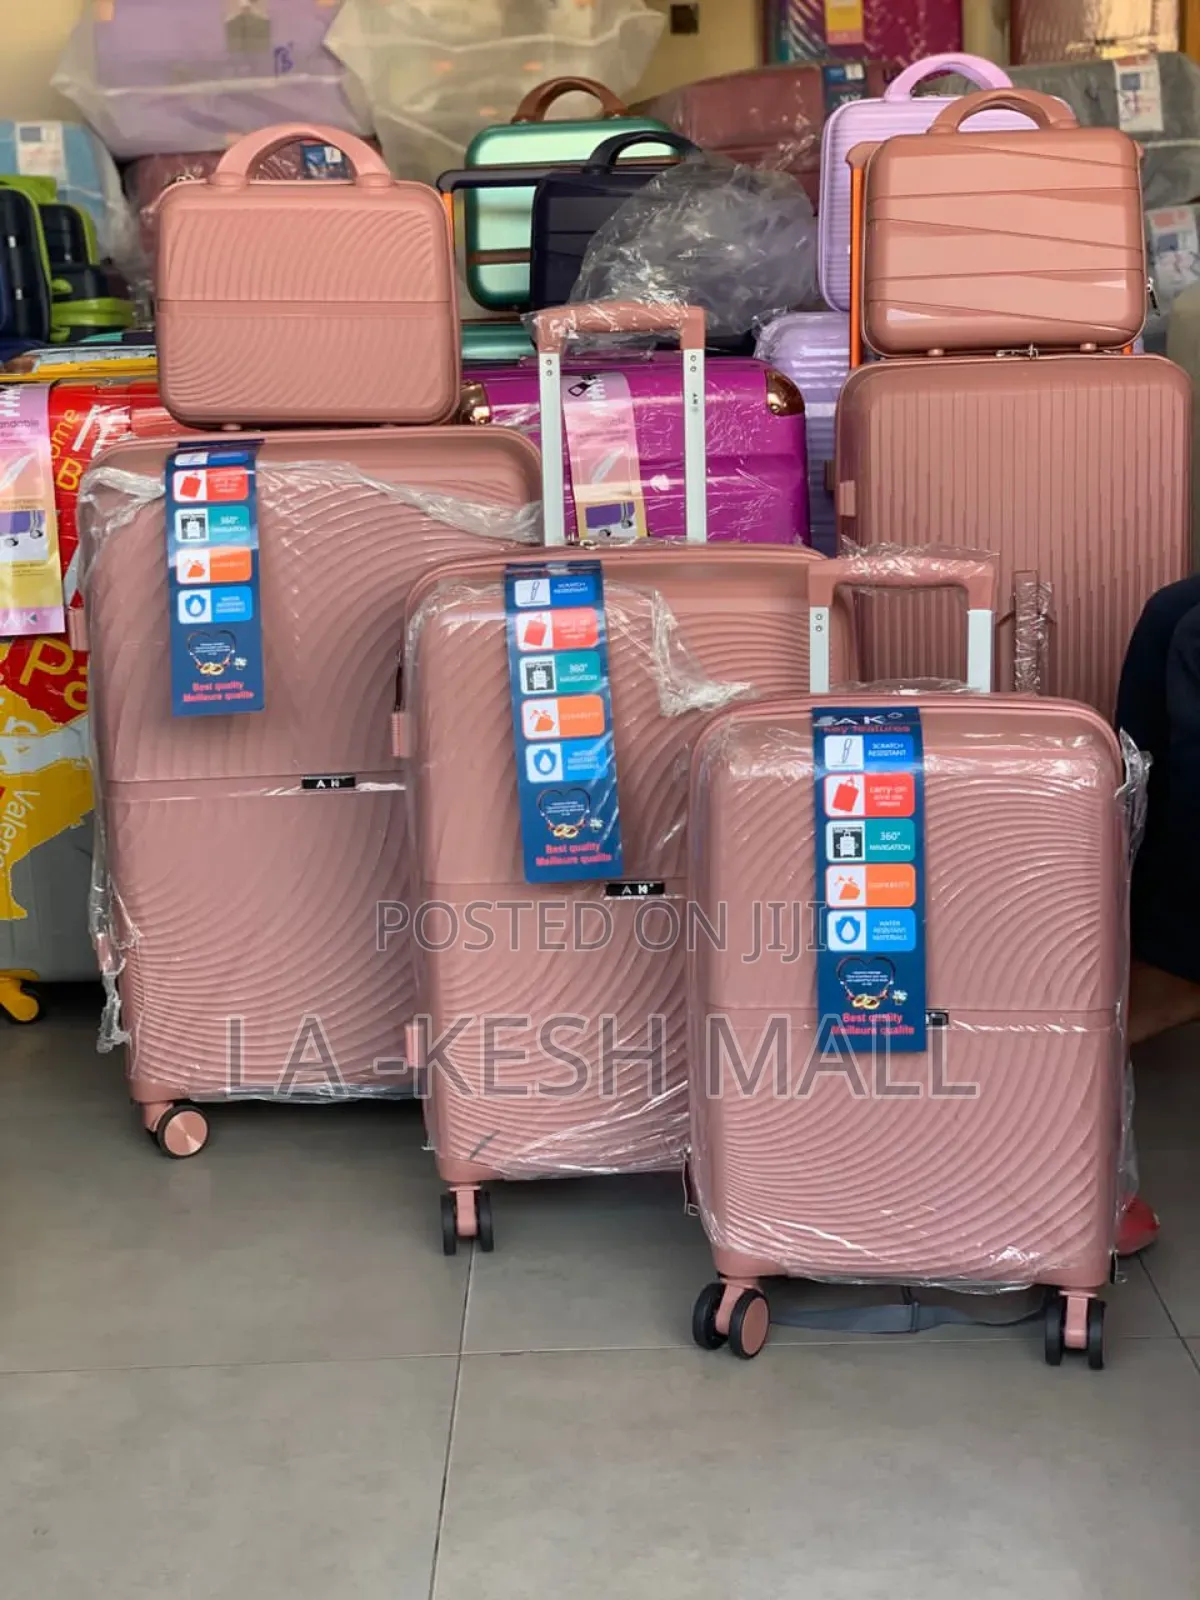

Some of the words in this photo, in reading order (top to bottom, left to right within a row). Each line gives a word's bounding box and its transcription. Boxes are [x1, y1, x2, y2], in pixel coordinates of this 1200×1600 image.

[192, 683, 213, 691] Best
[214, 681, 244, 692] quality
[872, 742, 905, 750] SCRATCH
[867, 749, 907, 757] RESISTANT
[879, 831, 901, 842] 360°
[545, 844, 568, 854] Best
[569, 843, 601, 854] quality
[869, 843, 911, 852] NAVIGATION
[842, 1013, 866, 1022] Best
[868, 1012, 903, 1024] quality
